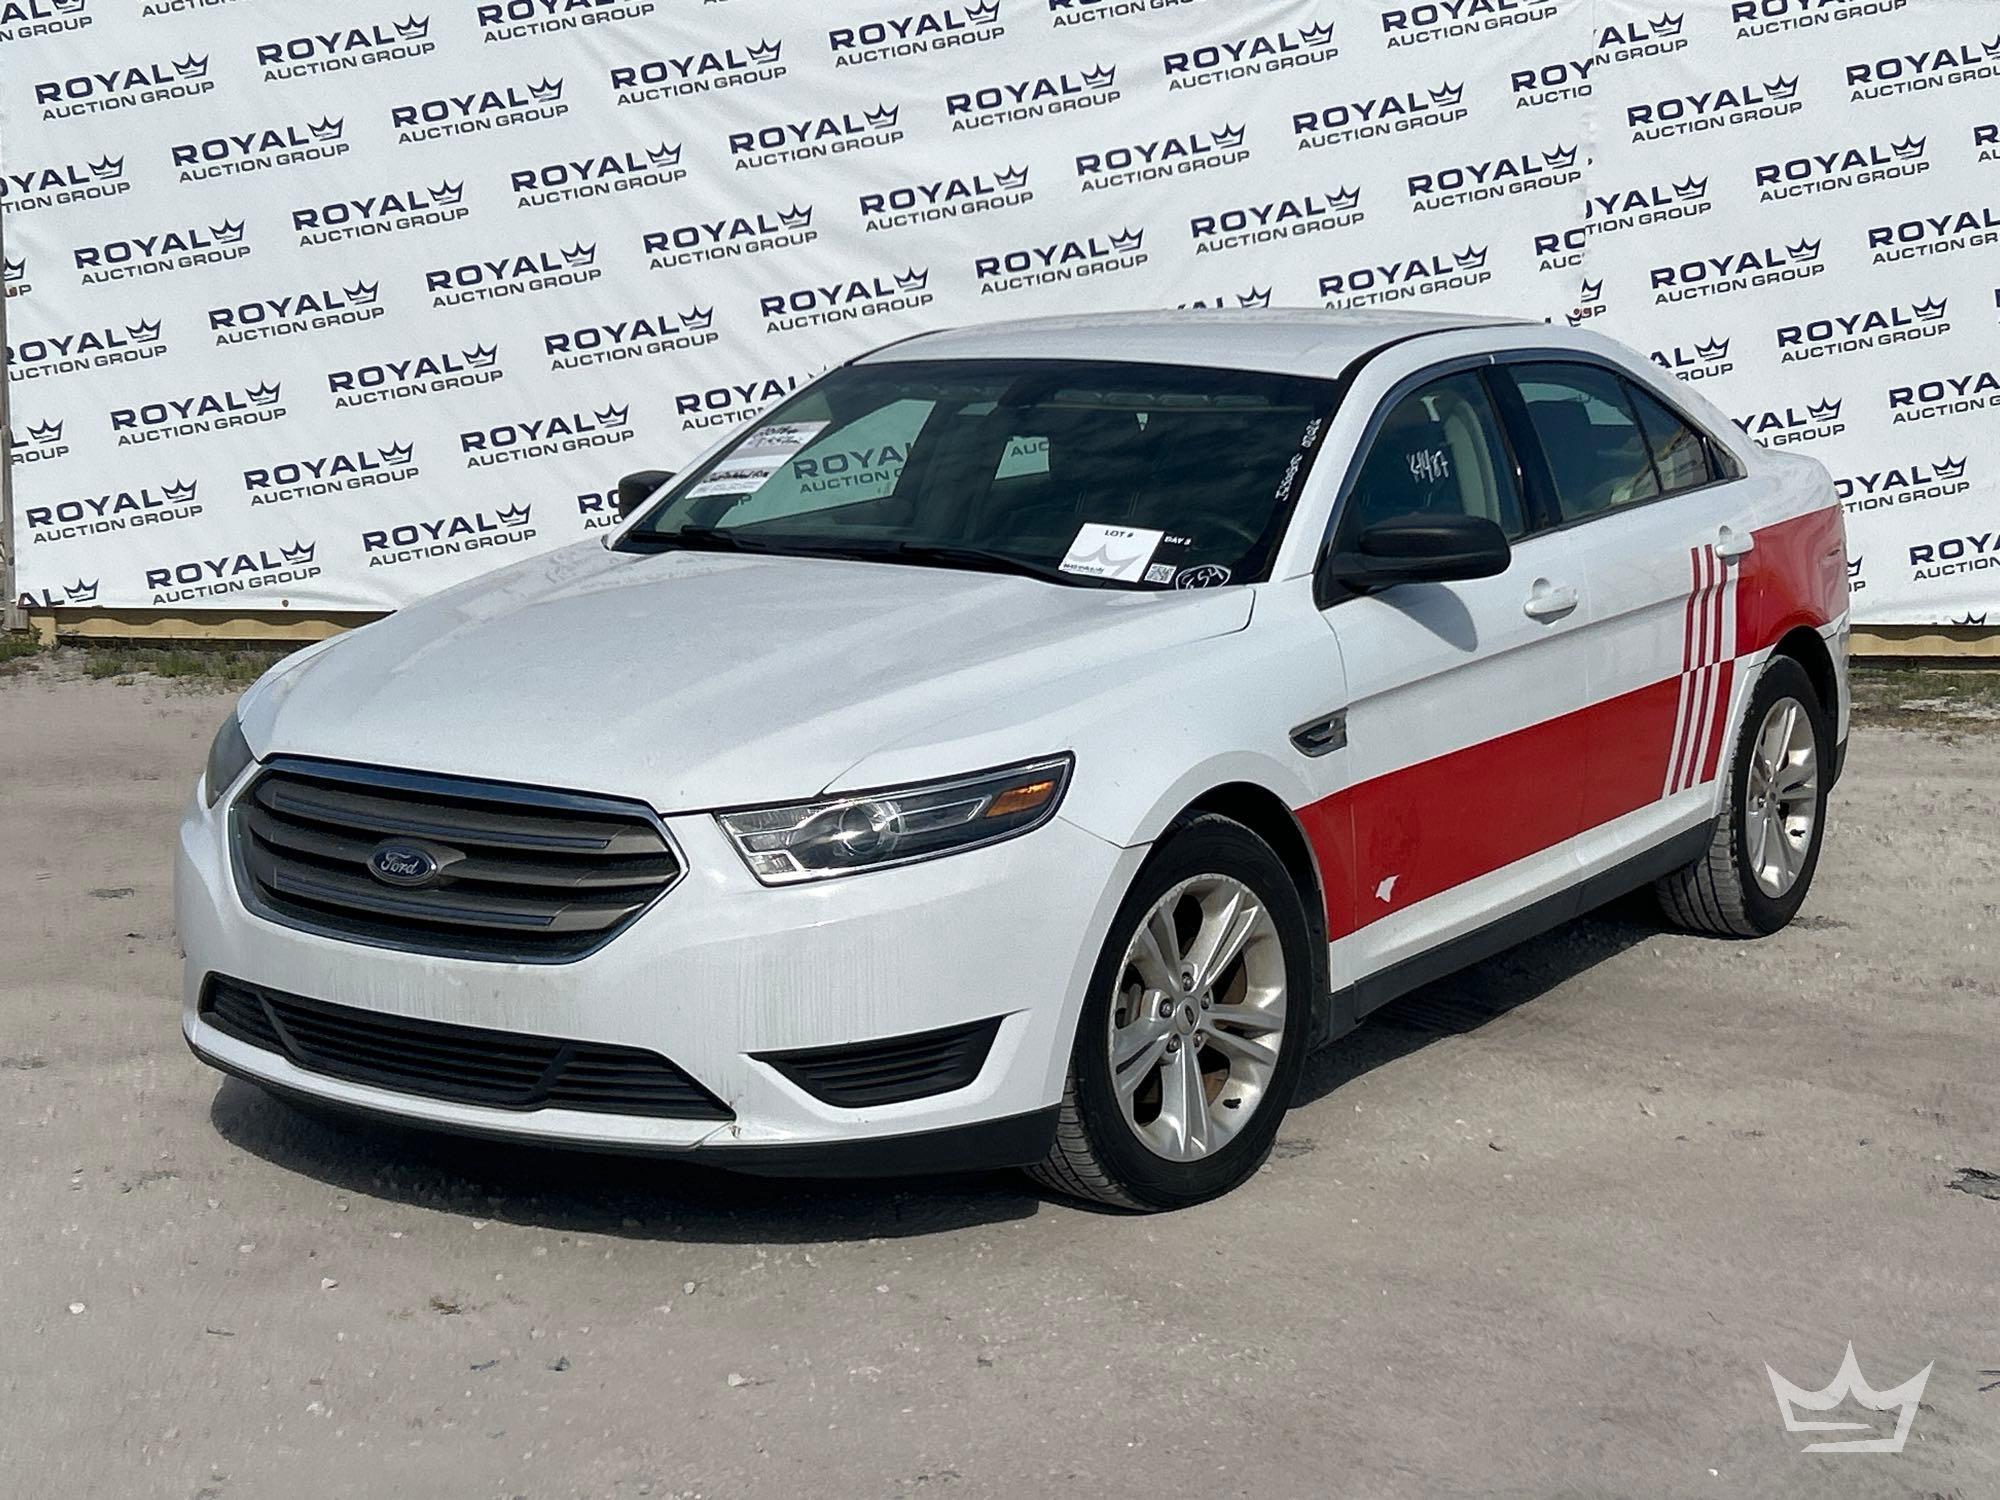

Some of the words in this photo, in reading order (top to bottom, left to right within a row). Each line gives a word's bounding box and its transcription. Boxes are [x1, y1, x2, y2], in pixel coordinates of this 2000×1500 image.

[18, 16, 92, 38] GROUP
[484, 16, 577, 43] AUCTION
[581, 3, 654, 25] GROUP
[829, 10, 966, 51] ROYAL
[1053, 0, 1145, 28] AUCTION
[1387, 21, 1480, 49] AUCTION
[1484, 6, 1557, 30] GROUP
[1736, 12, 1829, 40] AUCTION
[1834, 0, 1907, 21] GROUP
[256, 25, 395, 66] ROYAL
[264, 56, 357, 82] AUCTION
[361, 42, 435, 65] GROUP
[835, 41, 927, 68] AUCTION
[932, 27, 1005, 50] GROUP
[1163, 32, 1300, 75] ROYAL
[1615, 39, 1688, 62] GROUP
[1846, 45, 1982, 86] ROYAL
[35, 64, 175, 105] ROYAL
[610, 49, 747, 90] ROYAL
[617, 80, 710, 106] AUCTION
[714, 66, 787, 89] GROUP
[1169, 63, 1261, 91] AUCTION
[1266, 48, 1338, 72] GROUP
[1511, 57, 1593, 92] ROY
[1850, 75, 1943, 102] AUCTION
[43, 95, 136, 121] AUCTION
[140, 81, 214, 104] GROUP
[391, 87, 529, 128] ROYAL
[946, 74, 1082, 116] ROYAL
[952, 105, 1044, 132] AUCTION
[1048, 91, 1120, 114] GROUP
[1293, 92, 1429, 134] ROYAL
[1516, 84, 1592, 109] AUCTIO
[1627, 85, 1764, 127] ROYAL
[399, 118, 491, 144] AUCTION
[496, 104, 568, 127] GROUP
[729, 114, 865, 155] ROYAL
[1298, 123, 1390, 151] AUCTION
[1395, 108, 1468, 132] GROUP
[1632, 116, 1725, 143] AUCTION
[1729, 102, 1802, 124] GROUP
[171, 126, 310, 167] ROYAL
[179, 157, 272, 183] AUCTION
[276, 143, 349, 165] GROUP
[735, 144, 827, 171] AUCTION
[831, 131, 904, 153] GROUP
[1076, 134, 1211, 176] ROYAL
[1755, 145, 1891, 187] ROYAL
[511, 152, 648, 192] ROYAL
[518, 182, 610, 209] AUCTION
[614, 169, 687, 191] GROUP
[1081, 165, 1173, 192] AUCTION
[1177, 150, 1250, 174] GROUP
[1408, 155, 1543, 197] ROYAL
[1760, 175, 1852, 203] AUCTION
[1857, 162, 1929, 184] GROUP
[1, 195, 52, 213] TION
[56, 182, 131, 204] GROUP
[292, 191, 430, 231] ROYAL
[859, 175, 995, 216] ROYAL
[866, 205, 957, 232] AUCTION
[961, 191, 1033, 214] GROUP
[1413, 185, 1504, 213] AUCTION
[1509, 171, 1581, 194] GROUP
[300, 221, 392, 247] AUCTION
[396, 207, 469, 229] GROUP
[643, 214, 779, 254] ROYAL
[1191, 196, 1326, 239] ROYAL
[1196, 227, 1288, 255] AUCTION
[1292, 212, 1364, 236] GROUP
[1585, 217, 1633, 236] TION
[1638, 202, 1711, 225] GROUP
[74, 229, 211, 269] ROYAL
[81, 259, 174, 285] AUCTION
[178, 246, 251, 268] GROUP
[650, 244, 741, 270] AUCTION
[745, 231, 817, 253] GROUP
[975, 238, 1110, 279] ROYAL
[1650, 248, 1786, 289] ROYAL
[1872, 238, 1965, 265] AUCTION
[425, 252, 562, 292] ROYAL
[433, 282, 524, 308] AUCTION
[529, 269, 601, 291] GROUP
[981, 268, 1072, 295] AUCTION
[1076, 254, 1148, 277] GROUP
[1319, 256, 1453, 298] ROYAL
[1420, 271, 1491, 294] GROUP
[1655, 278, 1747, 305] AUCTION
[1752, 264, 1825, 286] GROUP
[208, 291, 345, 330] ROYAL
[760, 277, 895, 318] ROYAL
[767, 307, 857, 333] AUCTION
[862, 294, 933, 316] GROUP
[216, 320, 308, 346] AUCTION
[312, 307, 384, 329] GROUP
[544, 316, 680, 355] ROYAL
[1777, 307, 1912, 348] ROYAL
[1781, 337, 1873, 364] AUCTION
[1878, 323, 1950, 345] GROUP
[10, 358, 90, 382] UCTION
[94, 345, 167, 367] GROUP
[551, 345, 643, 371] AUCTION
[646, 332, 719, 354] GROUP
[328, 354, 464, 393] ROYAL
[335, 383, 427, 409] AUCTION
[431, 370, 503, 392] GROUP
[1676, 363, 1733, 382] ROUP
[1889, 372, 2000, 408] ROYA
[110, 391, 247, 431] ROYAL
[118, 421, 210, 446] AUCTION
[214, 408, 286, 429] GROUP
[1731, 408, 1807, 435] YAL
[1893, 398, 1985, 424] AUCTION
[460, 413, 596, 453] ROYAL
[467, 443, 558, 468] AUCTION
[562, 430, 634, 452] GROUP
[1773, 424, 1845, 446] GROUP
[11, 446, 69, 465] ROUP
[243, 451, 380, 490] ROYAL
[251, 480, 343, 506] AUCTION
[346, 467, 419, 489] GROUP
[800, 470, 890, 494] AUCTION
[1833, 466, 1932, 500] OYAL
[1845, 496, 1894, 513] TION
[1898, 481, 1970, 503] GROUP
[26, 489, 164, 528] ROYAL
[34, 518, 126, 544] AUCTION
[130, 505, 203, 527] GROUP
[362, 513, 498, 552] ROYAL
[369, 542, 461, 567] AUCTION
[464, 529, 536, 550] GROUP
[1104, 529, 1125, 538] LOT
[1164, 536, 1182, 544] DAY
[146, 551, 282, 590] ROYAL
[153, 580, 244, 605] AUCTION
[248, 567, 321, 588] GROUP
[1913, 557, 2000, 581] AUCTION
[380, 852, 419, 875] Ford
